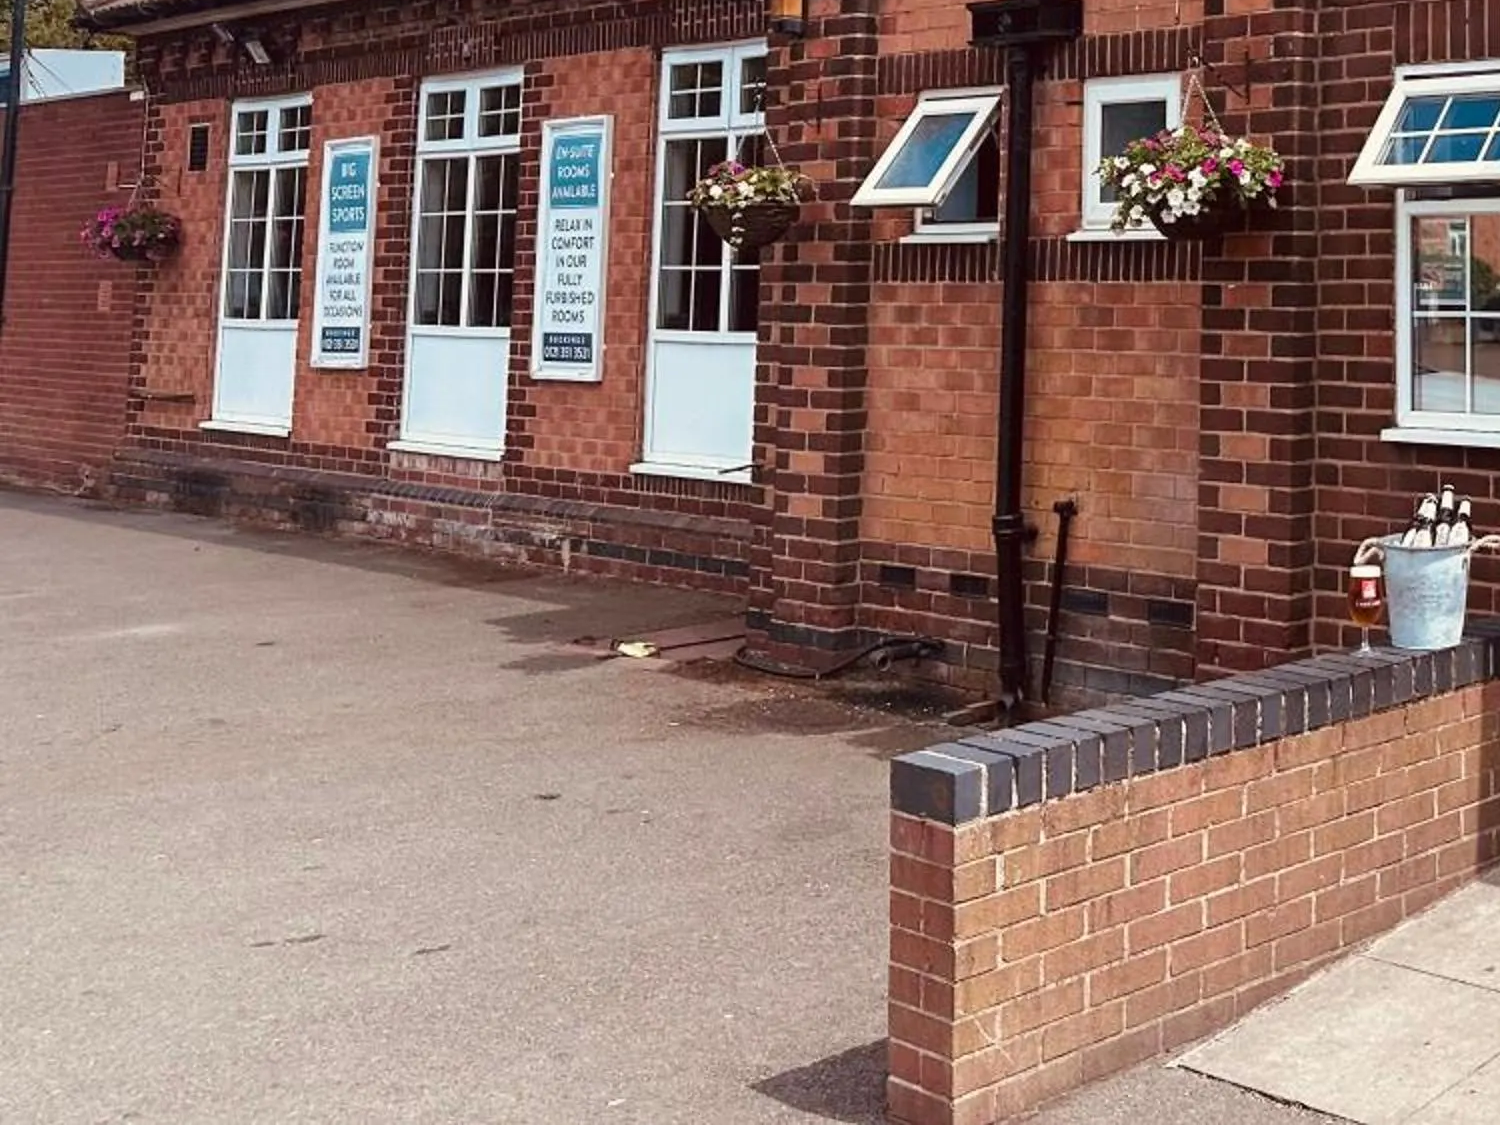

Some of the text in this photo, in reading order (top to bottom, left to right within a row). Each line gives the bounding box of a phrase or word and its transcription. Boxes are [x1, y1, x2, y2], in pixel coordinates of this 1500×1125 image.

[341, 162, 357, 178] BIG
[558, 164, 590, 179] ROOMS
[331, 183, 364, 201] SCREEN
[552, 183, 596, 199] AVAILABLE
[331, 206, 365, 223] SPORTS
[555, 218, 593, 232] RELAX IN
[329, 240, 364, 254] FUNCTION
[551, 236, 595, 250] COMFORT
[333, 257, 355, 269] ROOM
[556, 254, 587, 267] IN OUR
[326, 273, 361, 285] AVAILABLE
[557, 273, 583, 286] FULLY
[329, 289, 357, 301] FOR ALL
[323, 305, 362, 318] OCCASIONS
[551, 310, 585, 324] ROOMS
